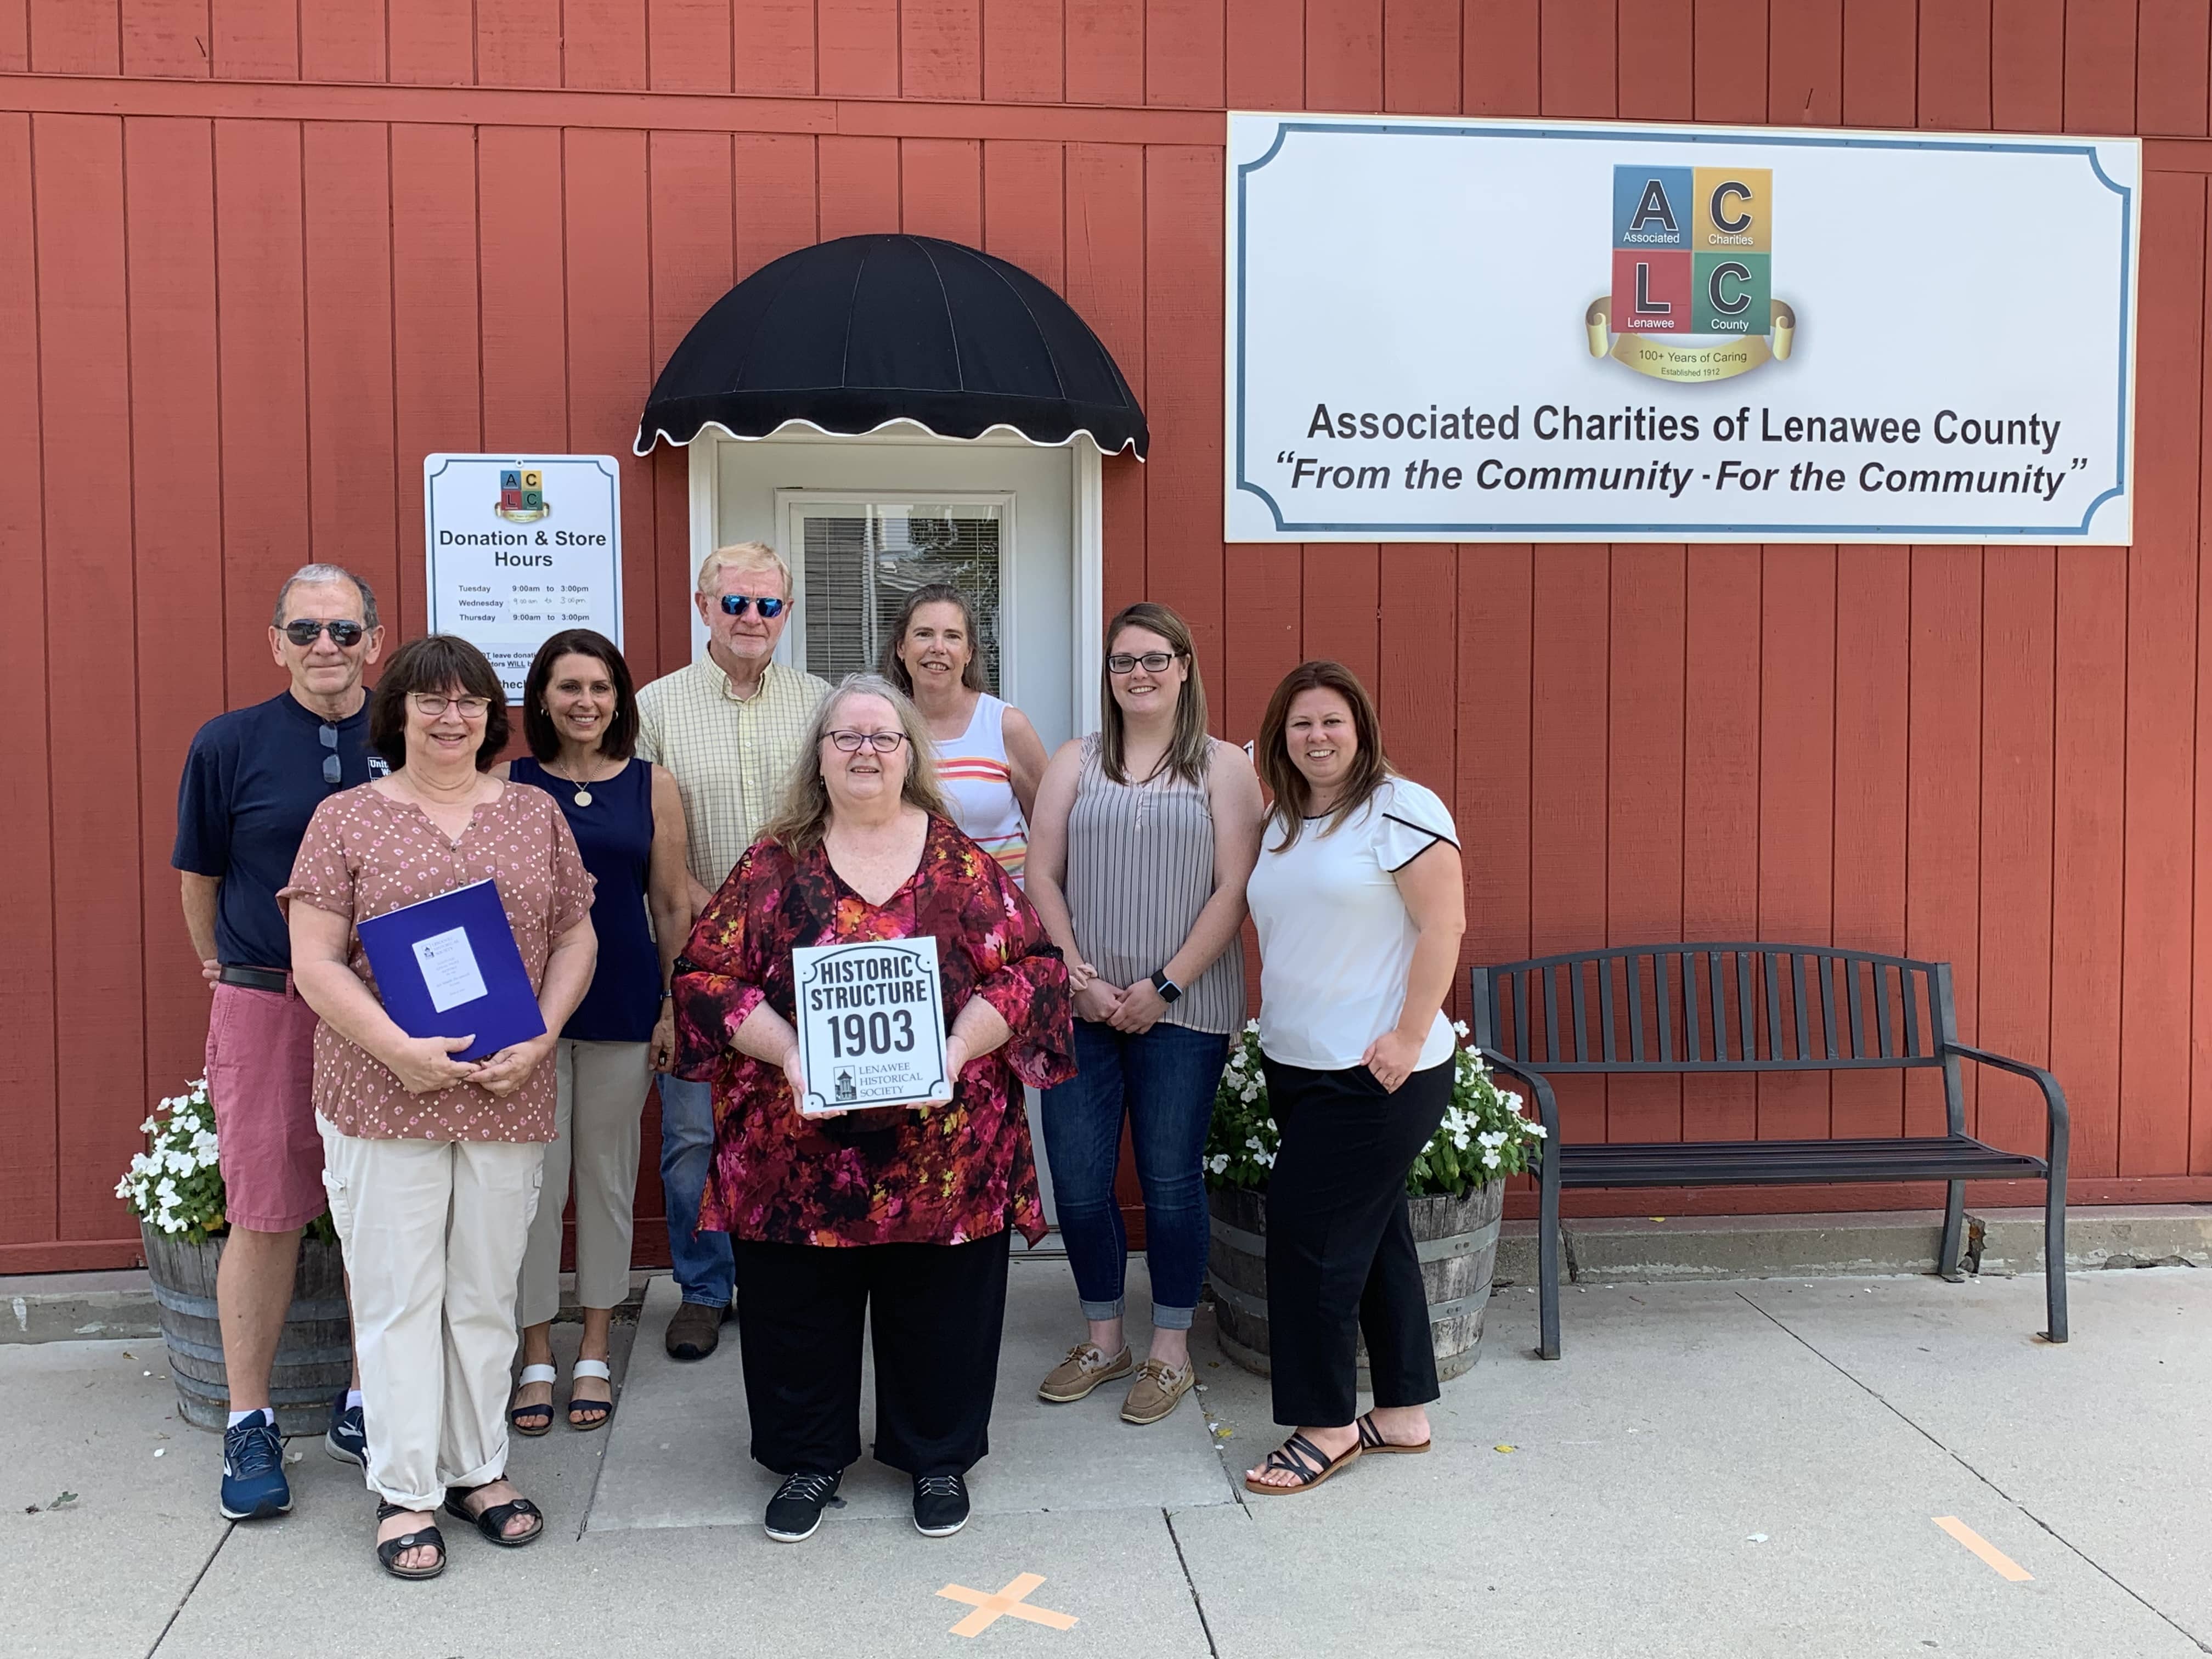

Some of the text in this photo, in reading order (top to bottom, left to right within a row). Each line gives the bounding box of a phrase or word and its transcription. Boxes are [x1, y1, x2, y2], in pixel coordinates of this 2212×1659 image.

[1630, 179, 1752, 233] A C
[1623, 233, 1754, 245] Associated Charities
[1635, 262, 1752, 314] L C
[1627, 317, 1749, 331] Lenawee County
[1639, 349, 1747, 363] 100+ Years of Caring
[1661, 367, 1701, 376] Established
[1307, 404, 2061, 454] Associated Charities of Lenawee County
[506, 473, 537, 486] A C
[1277, 451, 1390, 489] “From
[1404, 459, 1462, 490] the
[1476, 459, 1694, 498] Community
[1790, 462, 1846, 492] the
[507, 493, 537, 505] L C
[439, 531, 606, 546] Donation & Store
[494, 552, 553, 567] Hours
[459, 585, 491, 593] Tuesday
[459, 600, 504, 608] Wednesday
[460, 614, 495, 622] Thursday
[369, 760, 388, 768] Unit
[821, 956, 913, 985] HISTORIC
[811, 980, 927, 1011] STRUCTURE
[827, 1009, 915, 1058] 1903
[859, 1062, 910, 1075] LENAWEE
[860, 1073, 923, 1086] HISTORICAL
[860, 1085, 904, 1097] SOCIETY
